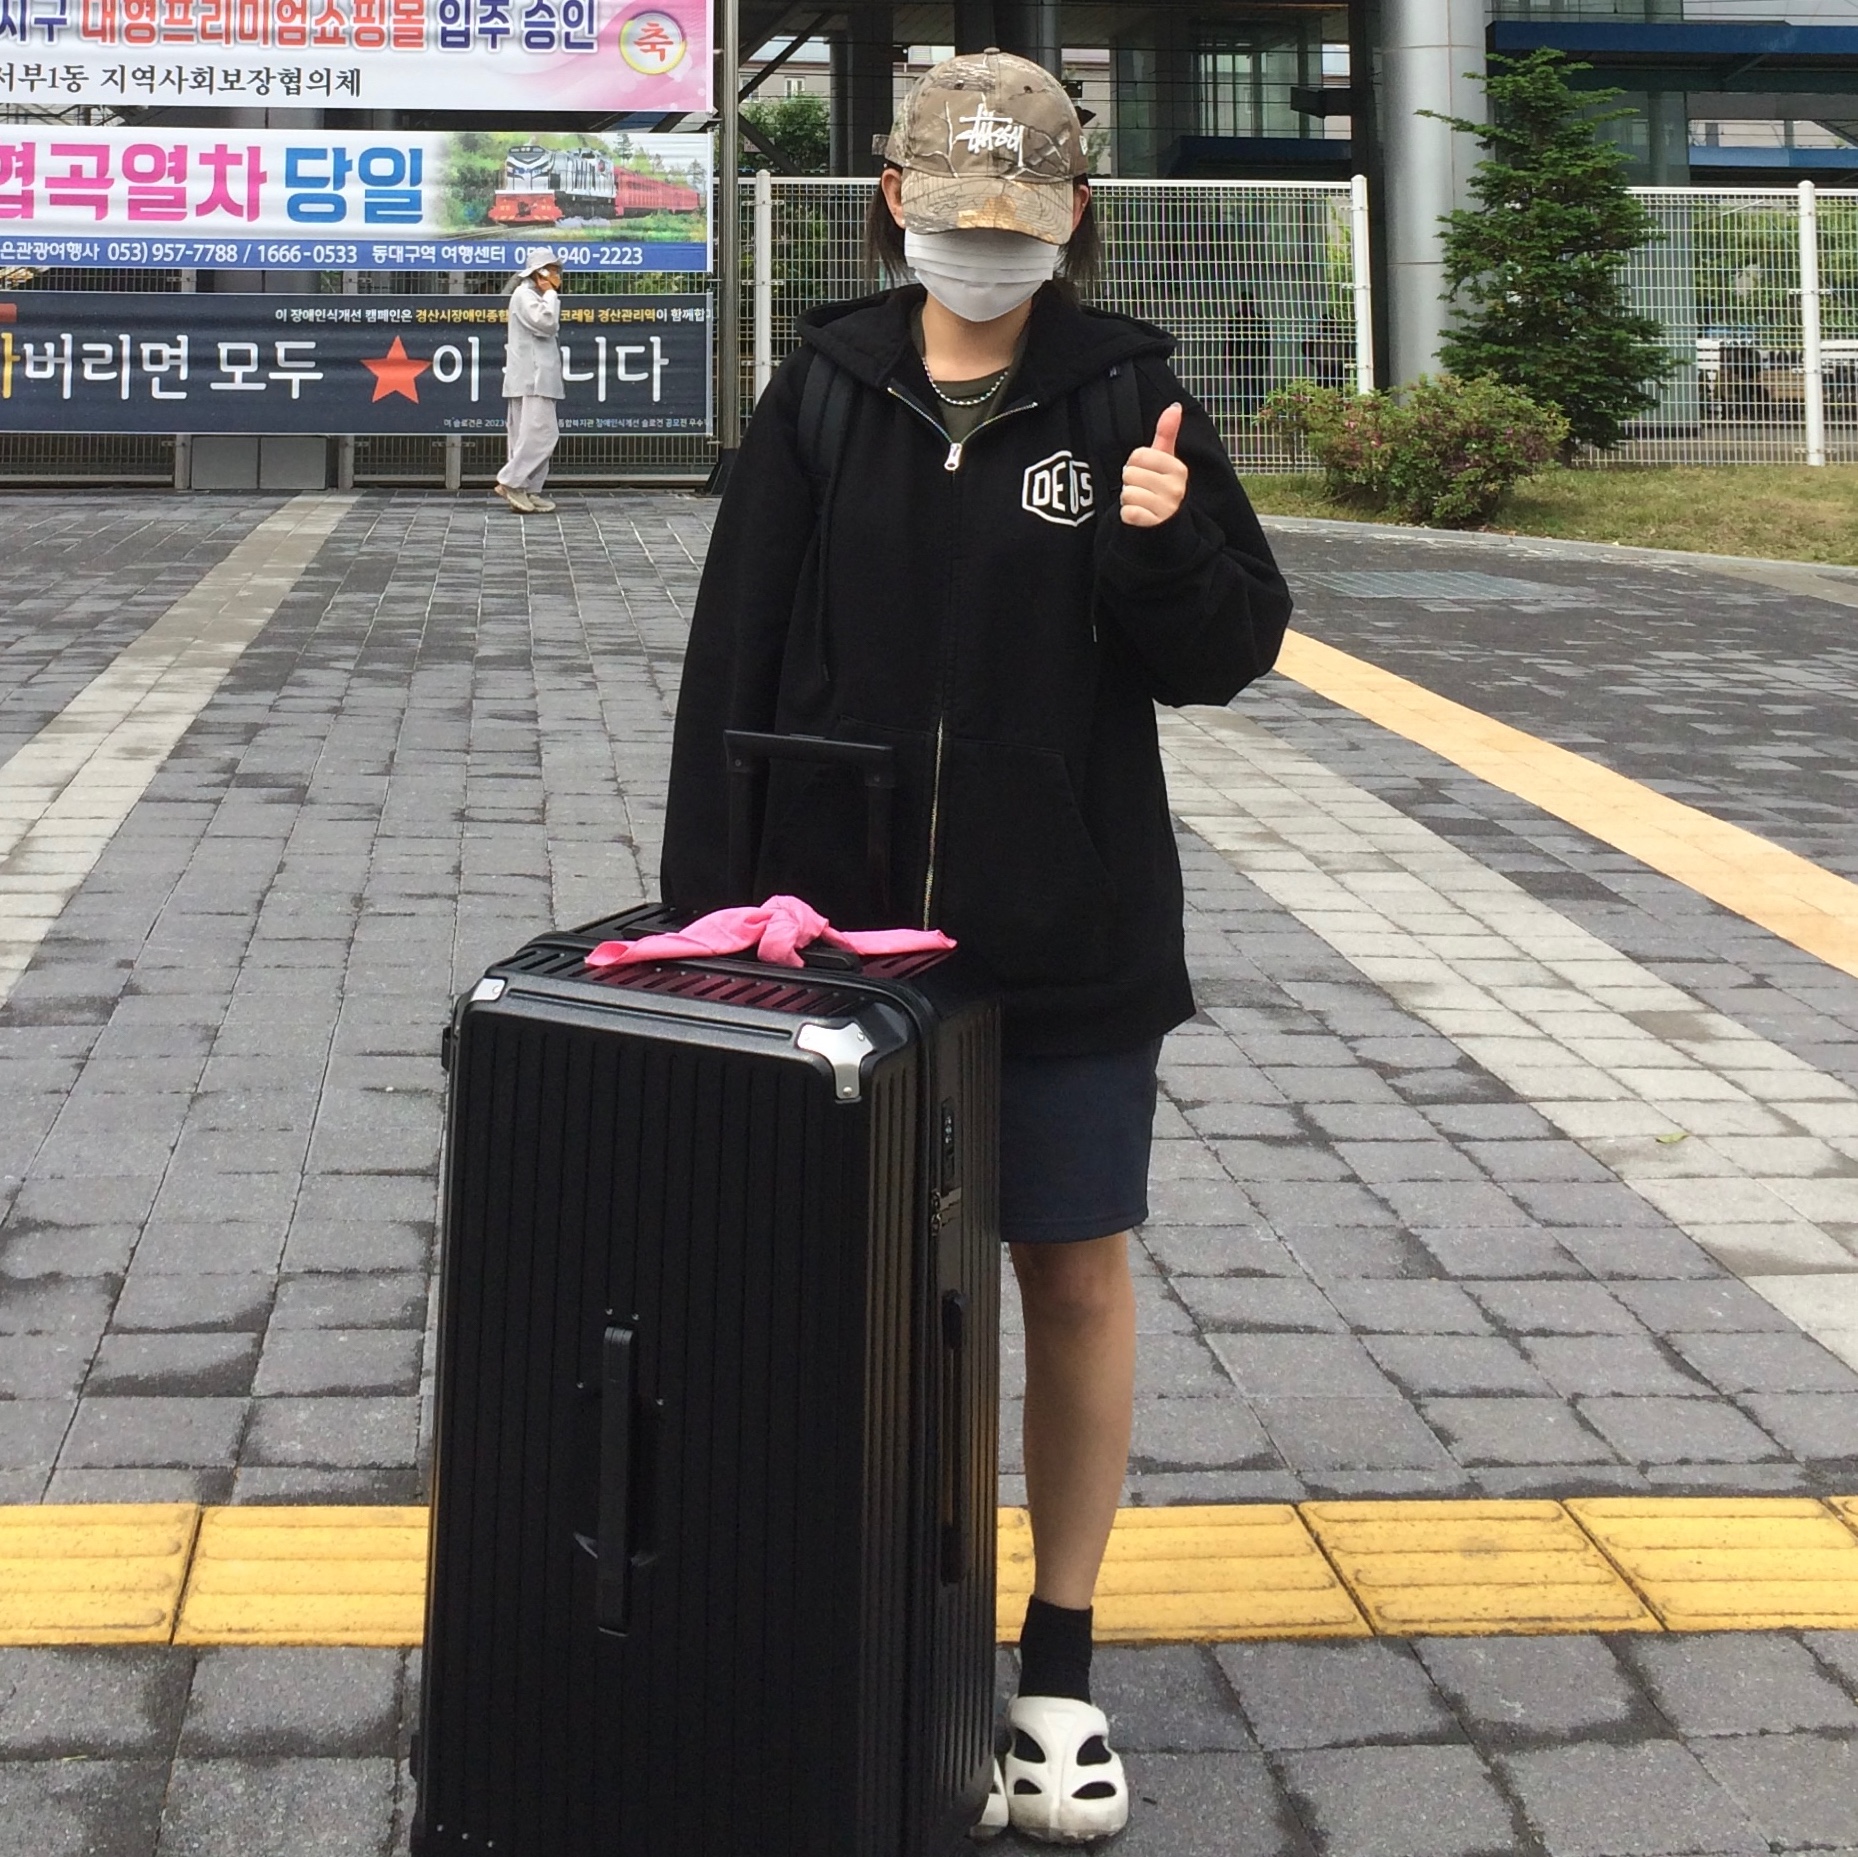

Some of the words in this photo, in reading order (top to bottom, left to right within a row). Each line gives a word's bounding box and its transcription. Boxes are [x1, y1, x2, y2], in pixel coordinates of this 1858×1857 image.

[438, 0, 511, 49] 입주
[522, 0, 596, 49] 승인
[633, 21, 675, 62] 축
[100, 63, 362, 98] 지역사회보장협의체
[285, 147, 423, 224] 당일
[108, 242, 148, 263] 053)
[152, 243, 238, 263] 957-7788
[257, 245, 358, 264] 1666-0533
[372, 245, 436, 264] 동대구역
[441, 246, 506, 264] 여행센터
[557, 246, 643, 265] 940-2223
[275, 309, 287, 322] 이
[290, 309, 362, 323] 장애인식개선
[365, 309, 413, 323] 캠페인은
[561, 308, 595, 323] 코레일
[598, 308, 668, 323] 경산관리역이
[0, 332, 188, 400] 버리면
[210, 341, 324, 400] 모두
[432, 336, 480, 402] 이
[502, 336, 669, 402] 니다
